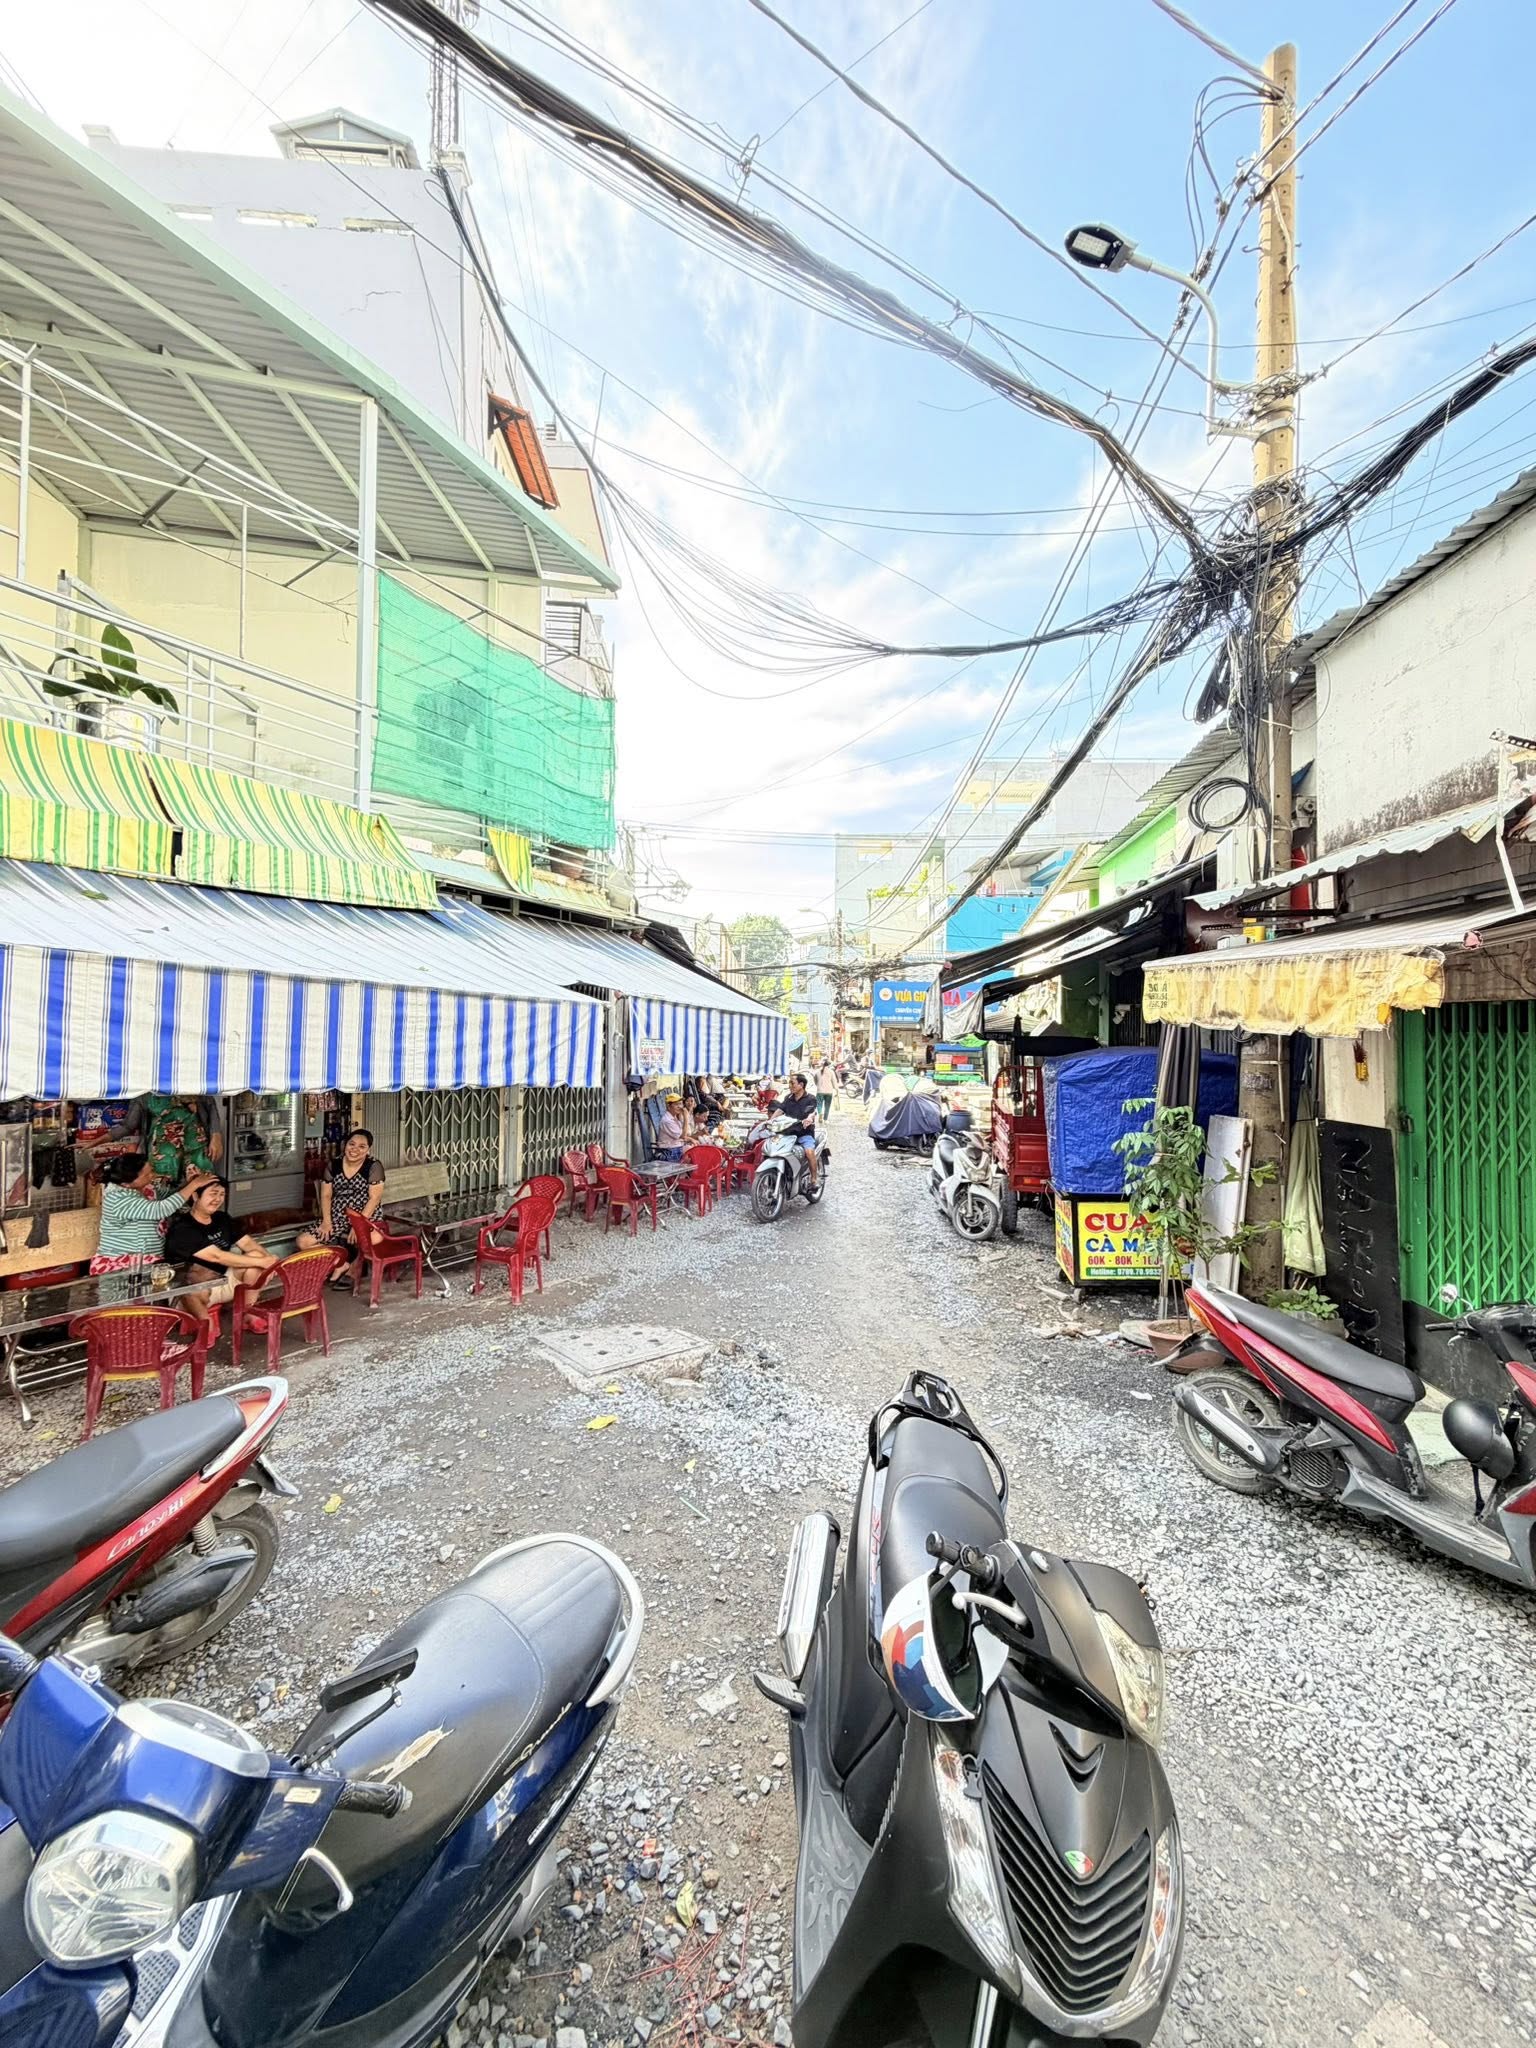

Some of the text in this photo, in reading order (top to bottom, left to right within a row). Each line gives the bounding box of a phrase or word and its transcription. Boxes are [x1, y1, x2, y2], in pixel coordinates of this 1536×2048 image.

[1085, 1213, 1153, 1231] CUA
[1086, 1234, 1116, 1252] CÀ
[1088, 1256, 1105, 1265] 60K
[1115, 1256, 1132, 1265] 80K
